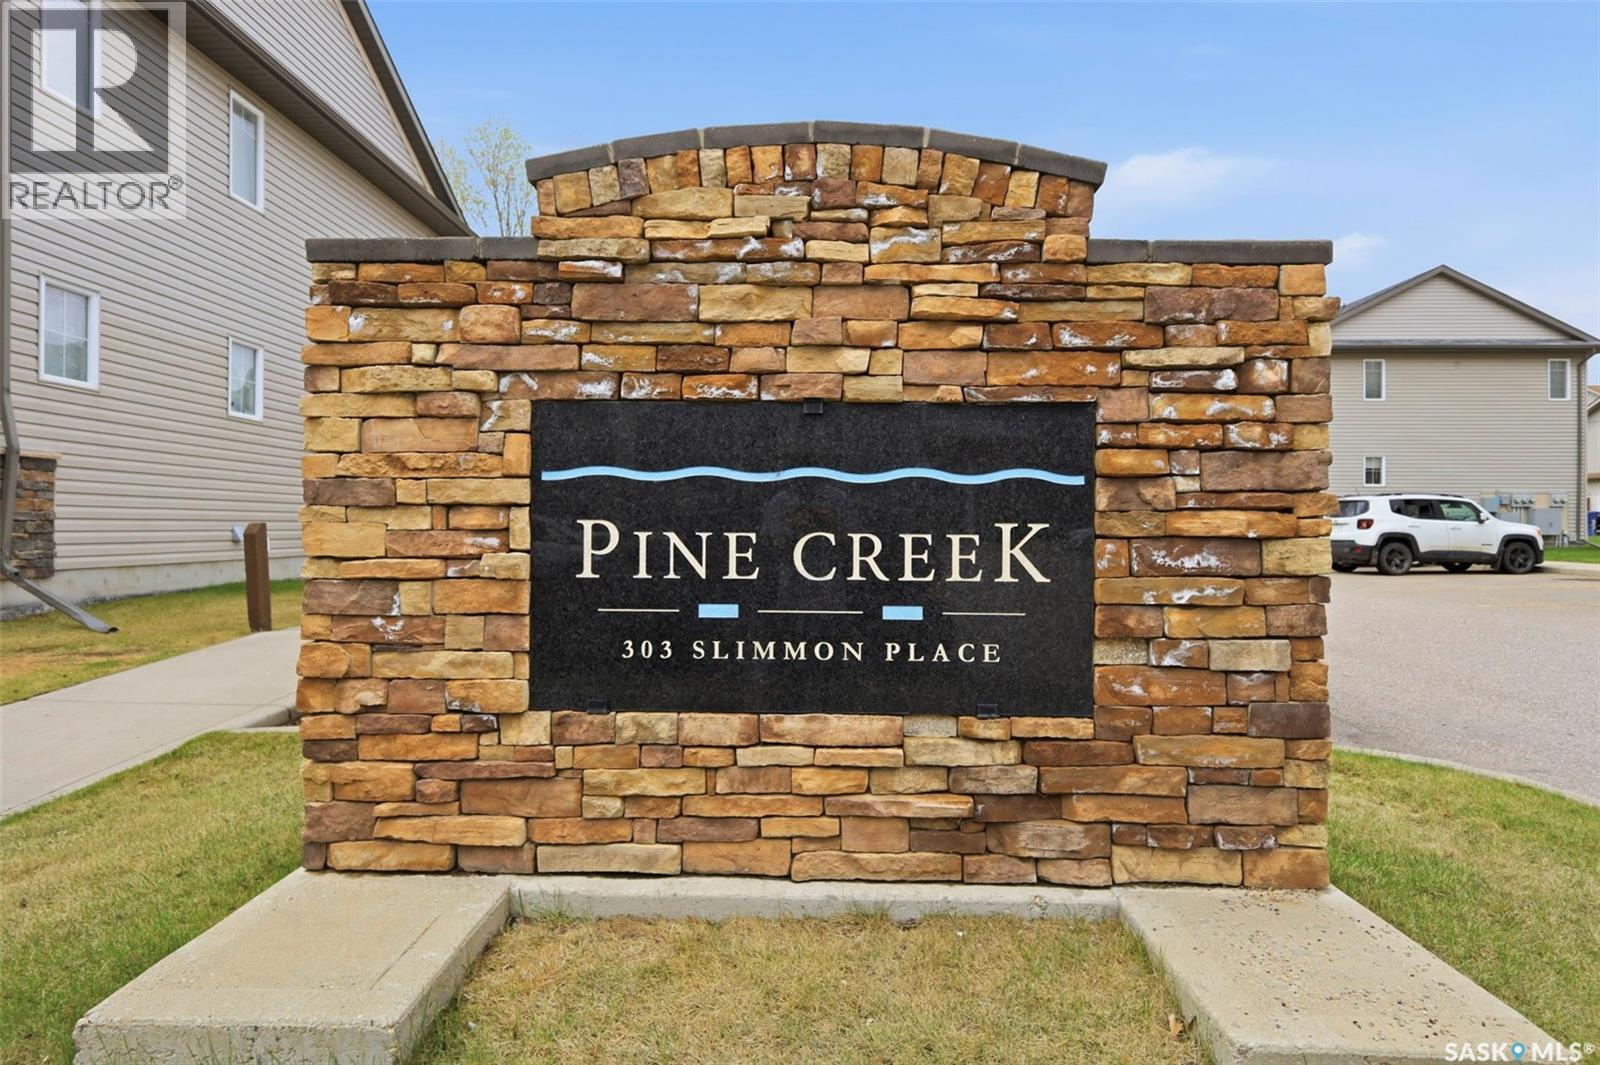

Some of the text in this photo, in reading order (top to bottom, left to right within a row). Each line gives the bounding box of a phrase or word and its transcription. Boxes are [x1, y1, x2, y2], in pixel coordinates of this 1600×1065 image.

[576, 520, 1051, 582] PINE CREEK
[622, 640, 1000, 662] 303 SLIMMON PLACE
